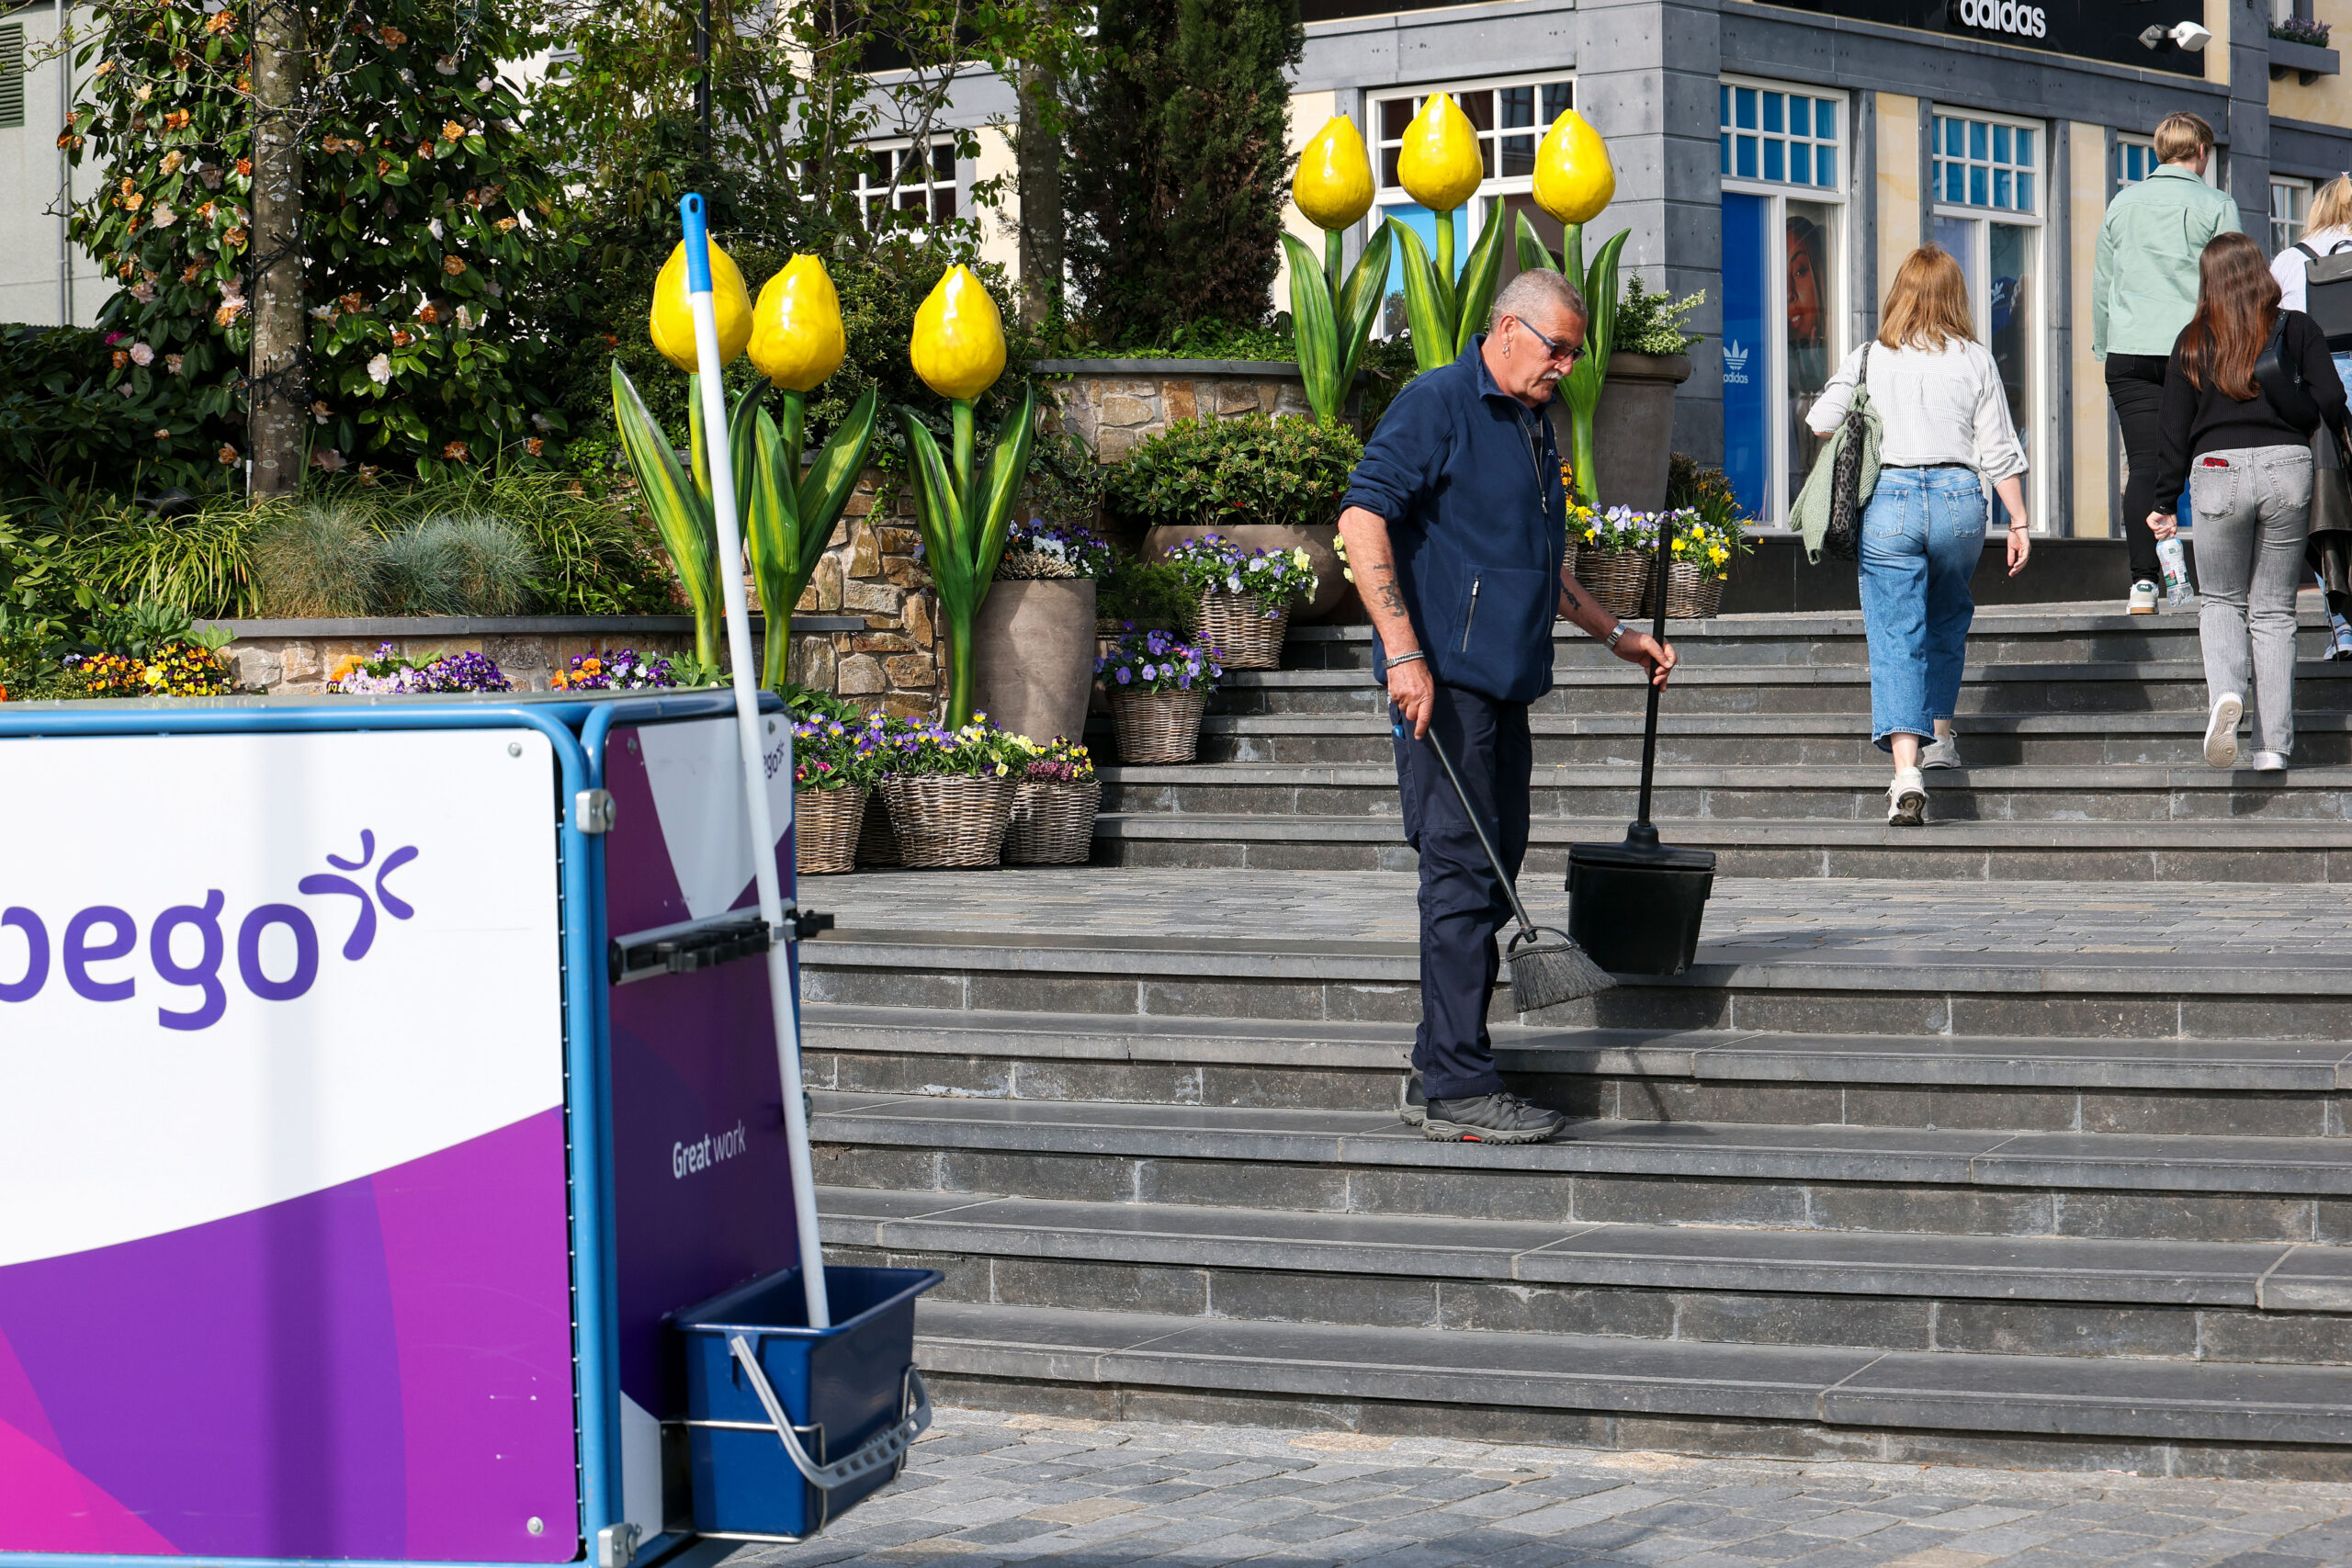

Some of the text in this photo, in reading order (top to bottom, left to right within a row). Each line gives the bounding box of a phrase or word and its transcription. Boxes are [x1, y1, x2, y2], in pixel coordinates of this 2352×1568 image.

[1960, 0, 2046, 39] adidas
[1723, 371, 1748, 384] adidas
[673, 1119, 746, 1179] Great work
